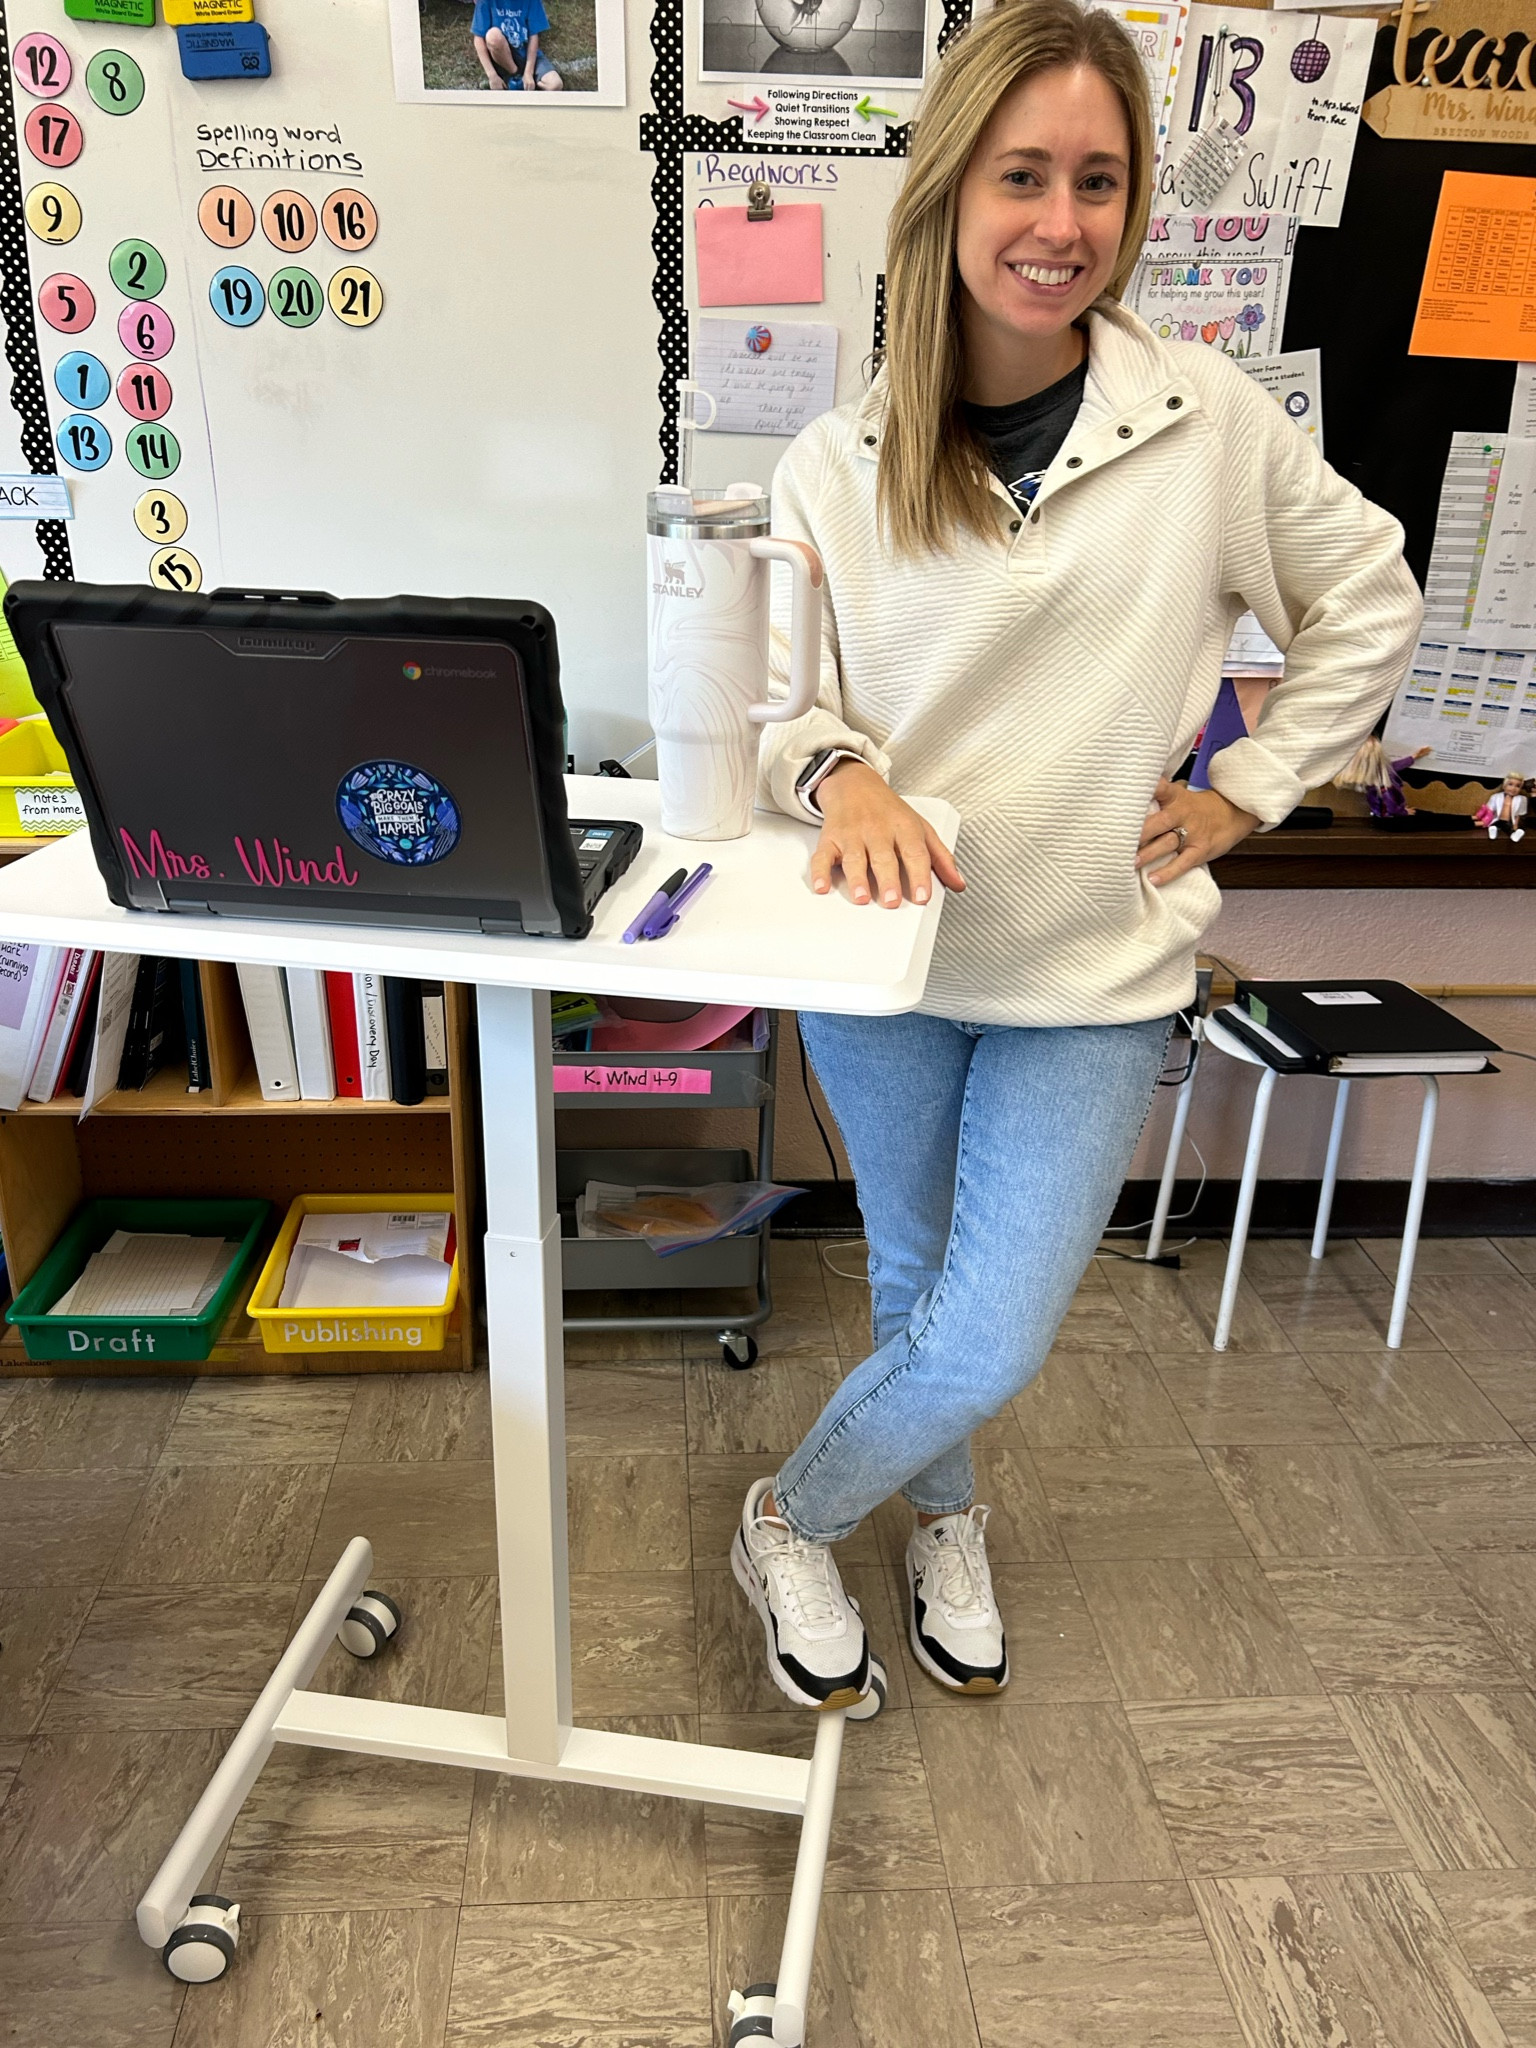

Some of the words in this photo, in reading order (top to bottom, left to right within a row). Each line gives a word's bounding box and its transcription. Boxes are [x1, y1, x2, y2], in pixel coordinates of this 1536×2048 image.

[95, 0, 144, 11] MAGNETIC
[194, 0, 243, 10] MAGNETIC
[25, 45, 60, 87] 12
[101, 61, 127, 102] 8
[767, 89, 811, 102] Following
[812, 90, 858, 101] Directions
[775, 103, 800, 113] Quiet
[802, 104, 850, 114] Transitions
[1423, 92, 1475, 122] Mrs.
[774, 116, 813, 128] Showing
[814, 118, 850, 128] Respect
[1492, 129, 1530, 140] WOODS
[38, 115, 70, 156] 17
[196, 124, 278, 147] Spelling
[747, 129, 785, 140] Keeping
[786, 130, 802, 139] the
[803, 131, 850, 141] Classroom
[851, 132, 877, 142] Clean
[198, 149, 363, 172] Definitions
[1243, 152, 1333, 216] Swift
[42, 195, 63, 233] 9
[217, 197, 236, 238] 4
[272, 202, 304, 243] 10
[333, 202, 365, 241] 16
[1191, 215, 1270, 243] YOU
[127, 251, 147, 290] 2
[1151, 267, 1213, 286] THANK
[1221, 267, 1268, 286] YOU
[57, 285, 77, 322] 5
[221, 278, 252, 317] 19
[277, 278, 313, 317] 20
[341, 278, 371, 317] 21
[1148, 288, 1159, 298] for
[1161, 287, 1188, 301] helping
[1204, 290, 1224, 301] grow
[1227, 288, 1242, 298] this
[1243, 288, 1265, 301] year!
[136, 314, 156, 351] 6
[77, 364, 90, 400] 1
[131, 374, 157, 411] 11
[68, 426, 100, 461] 13
[137, 434, 170, 470] 14
[151, 500, 170, 535] 3
[158, 553, 193, 592] 15
[652, 583, 704, 599] STANLEY
[423, 664, 498, 680] chromebook
[33, 792, 68, 804] notes
[370, 801, 393, 815] BIG
[393, 801, 424, 814] GOALS
[376, 788, 416, 803] CRAZY
[22, 804, 50, 815] from
[377, 816, 425, 836] HAPPEN
[120, 828, 225, 880] Mrs.
[235, 836, 359, 887] Wind
[366, 1000, 378, 1046] Discovery
[366, 1049, 379, 1068] Day
[584, 1069, 601, 1086] K.
[607, 1068, 648, 1086] Wind
[68, 1328, 155, 1353] Draft
[284, 1320, 422, 1347] Publishing
